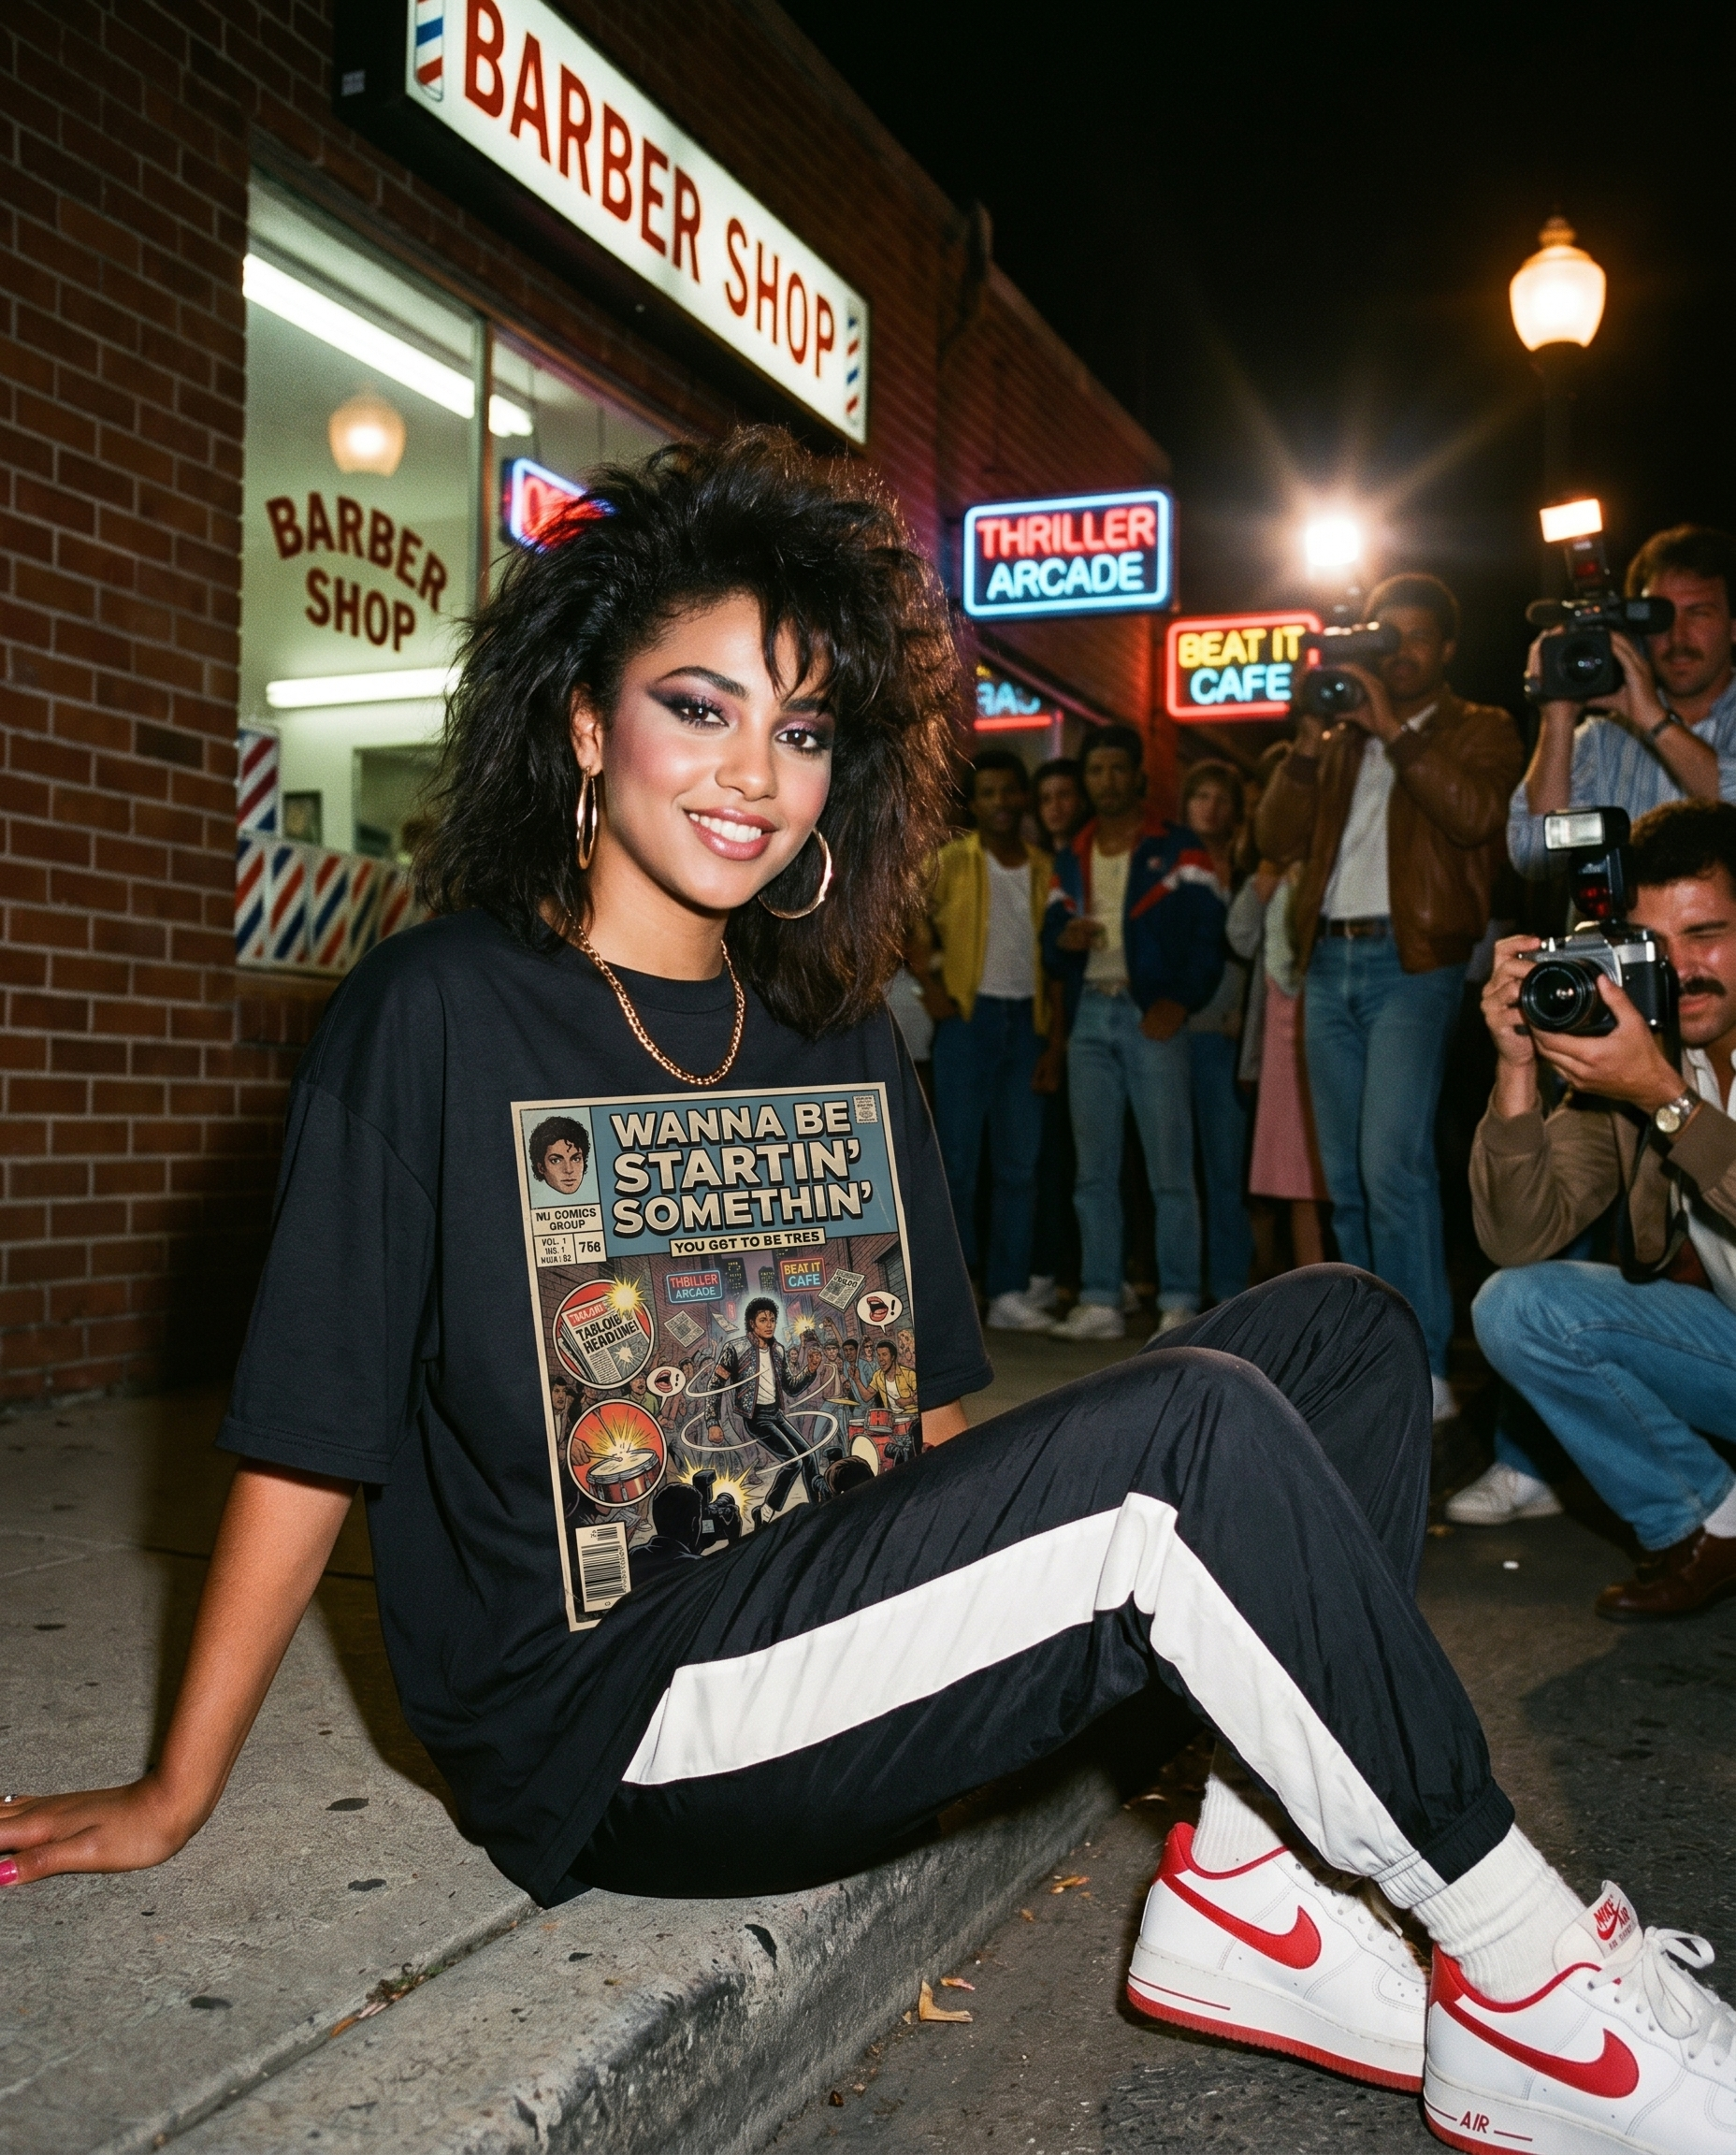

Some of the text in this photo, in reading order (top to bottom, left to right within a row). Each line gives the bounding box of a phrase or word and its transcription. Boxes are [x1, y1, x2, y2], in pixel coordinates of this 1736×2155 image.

[464, 0, 835, 378] BARBER SHOP
[266, 492, 448, 614] BARBER
[976, 505, 1156, 559] THRILLER
[987, 550, 1145, 601] ARCADE
[305, 567, 416, 652] SHOP
[1179, 625, 1306, 668] BEAT IT
[1190, 662, 1293, 704] CAFE
[610, 1105, 788, 1150] WANNA
[793, 1101, 852, 1138] BE
[614, 1138, 861, 1197] STARTIN'
[549, 1219, 586, 1231] GROUP
[555, 1208, 597, 1220] COMICS
[613, 1180, 874, 1237] SOMETHIN'
[542, 1237, 559, 1247] VOL.
[674, 1240, 705, 1253] YOU
[741, 1236, 760, 1248] TO
[763, 1234, 782, 1246] BE
[784, 1262, 821, 1276] BEAT IT
[788, 1273, 821, 1288] CAFE
[675, 1286, 716, 1299] ARCADE
[1460, 2110, 1490, 2133] AIR
